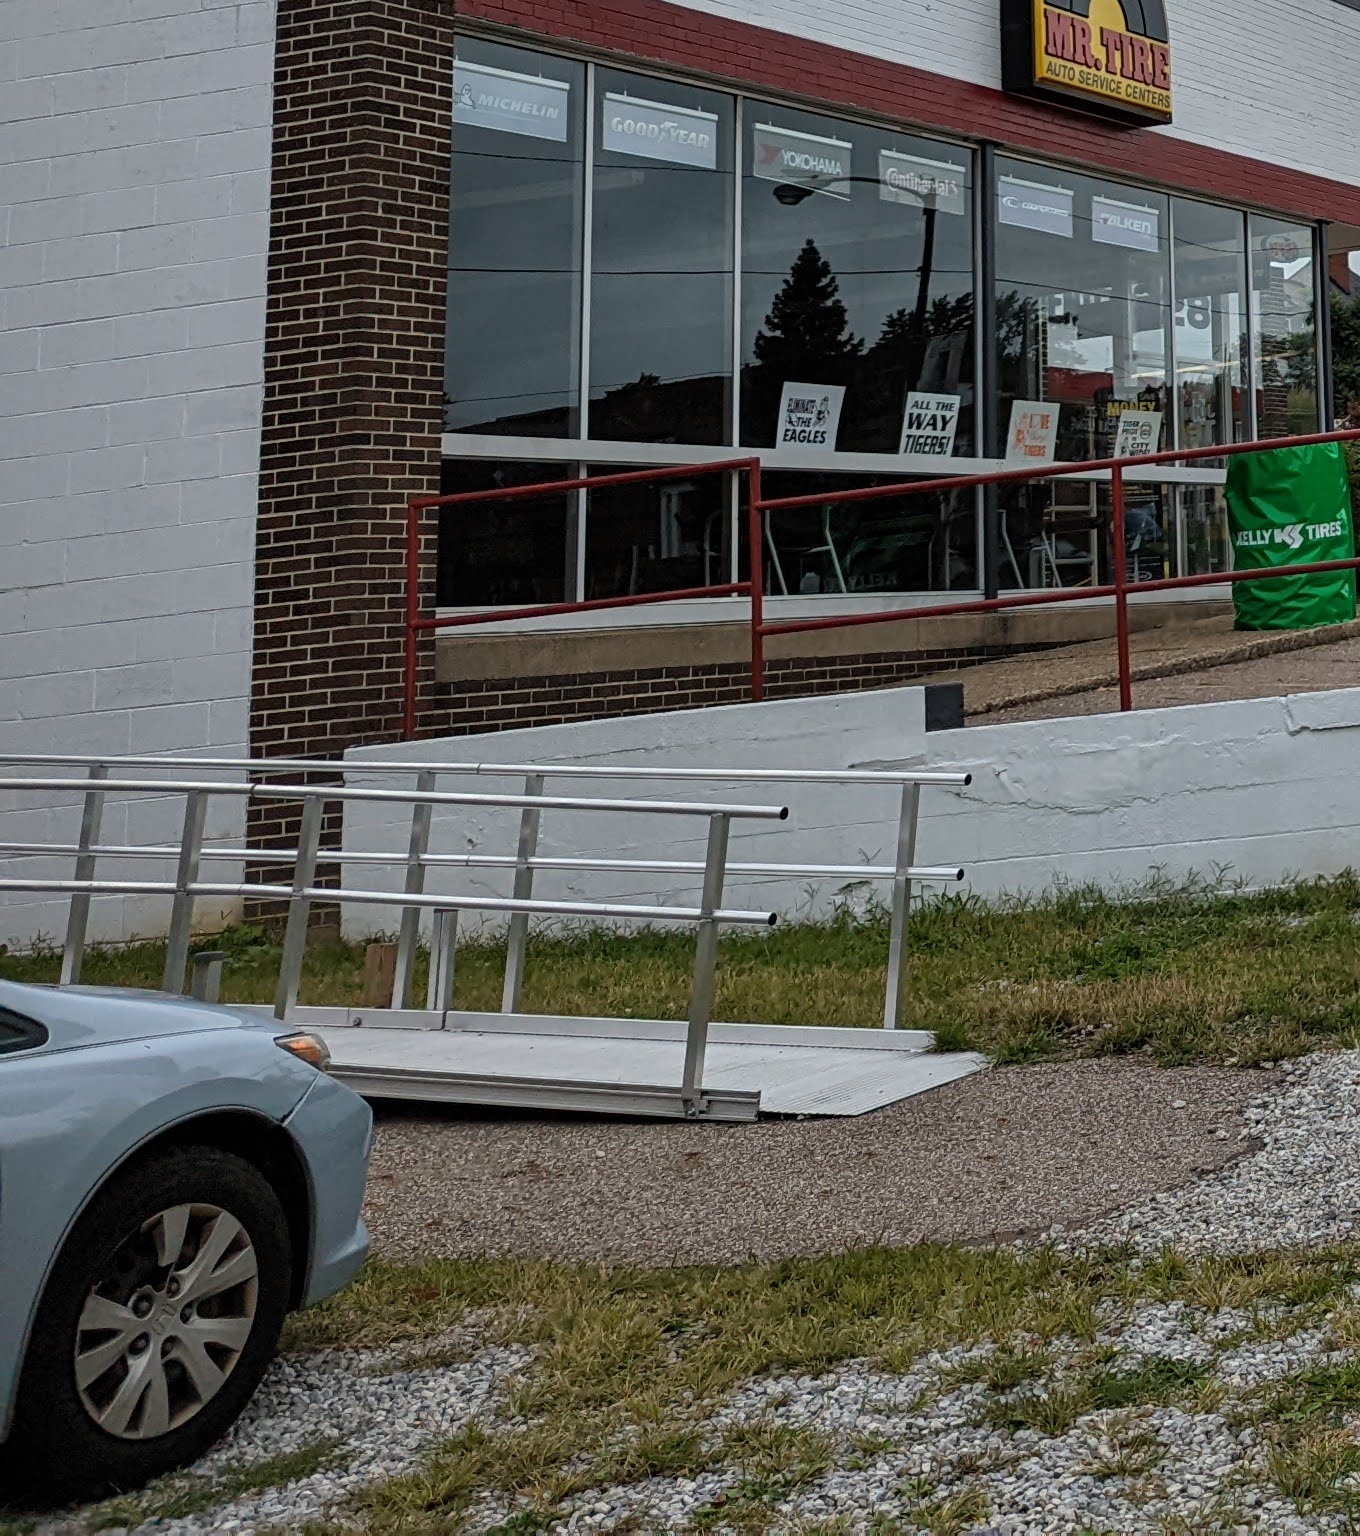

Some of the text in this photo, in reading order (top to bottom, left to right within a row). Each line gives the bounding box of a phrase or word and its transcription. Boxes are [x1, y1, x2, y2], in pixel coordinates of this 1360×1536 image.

[1046, 61, 1171, 108] AUTO SERVICE CENTERS
[477, 92, 560, 119] MICHELIN
[781, 149, 842, 176] YOKOHAMA
[911, 399, 956, 412] ALL THE
[796, 417, 812, 428] THE
[907, 412, 955, 432] WAY
[782, 428, 827, 444] EAGLES
[903, 433, 952, 456] TIGERS!
[1131, 442, 1150, 450] CITY
[1236, 529, 1272, 546] KELLY
[1306, 521, 1342, 540] TIRES
